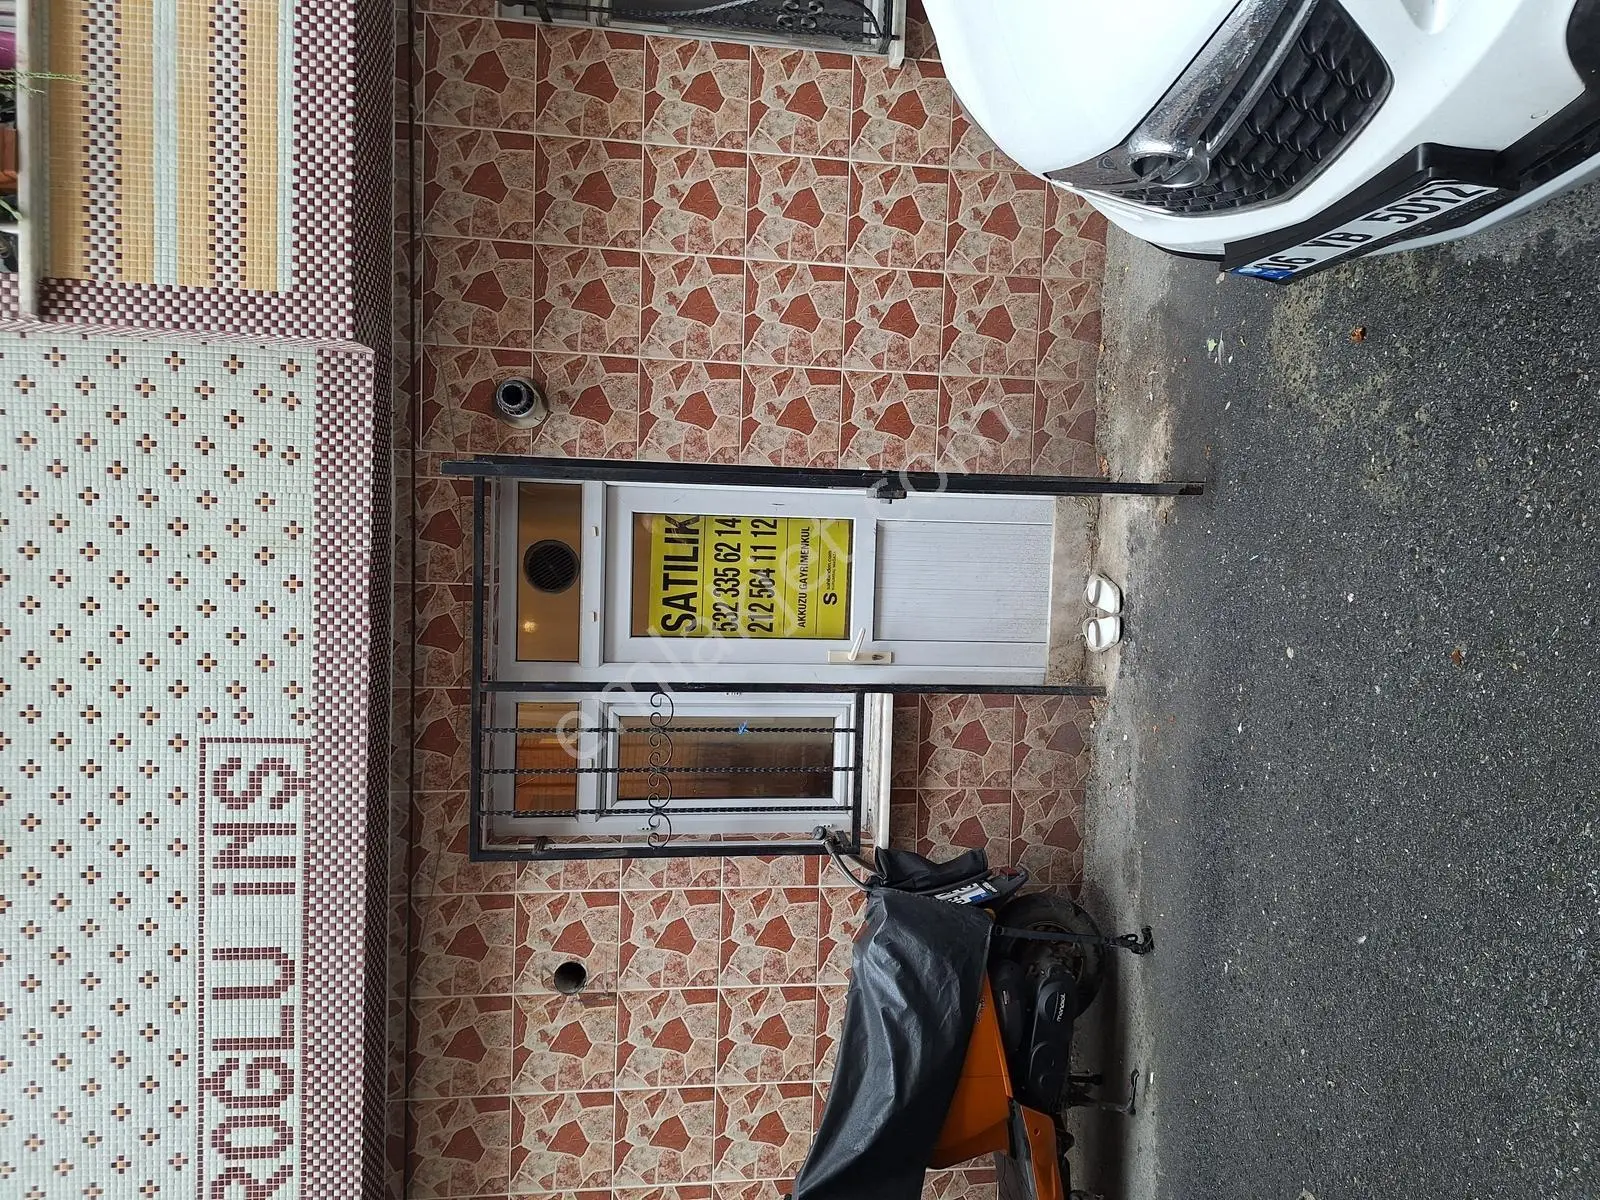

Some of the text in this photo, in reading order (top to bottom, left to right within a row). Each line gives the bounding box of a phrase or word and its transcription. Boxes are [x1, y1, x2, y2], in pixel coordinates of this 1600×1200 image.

[1298, 232, 1373, 249] YB
[1364, 185, 1487, 224] 5012
[660, 515, 700, 633] SATILIK
[712, 518, 742, 632] 532 335 62 14
[747, 519, 778, 633] 212 564 11 12
[797, 526, 811, 628] AKKUZU GAYRİMENKUL
